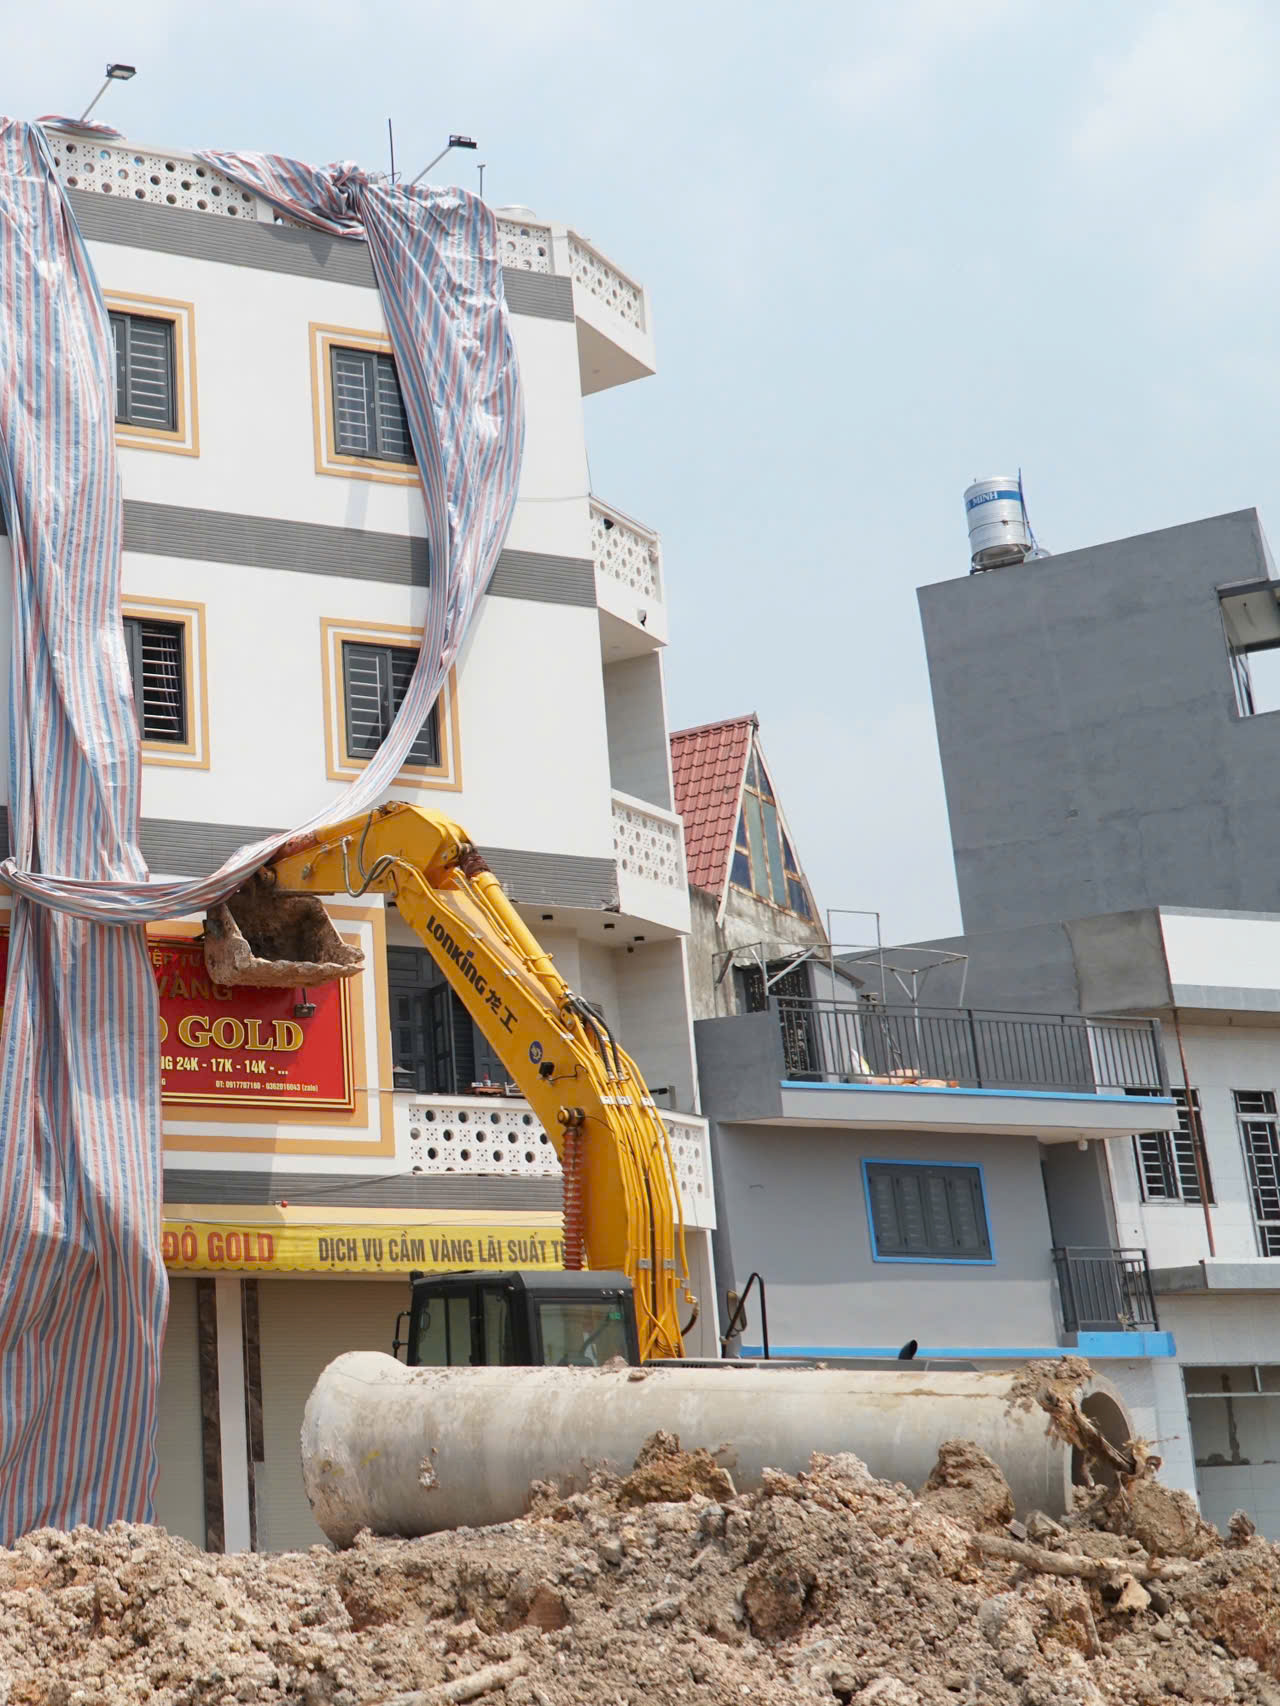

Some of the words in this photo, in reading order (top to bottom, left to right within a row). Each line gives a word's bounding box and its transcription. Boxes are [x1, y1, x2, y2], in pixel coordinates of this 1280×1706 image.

[178, 1015, 304, 1051] GOLD
[176, 1057, 199, 1071] 24K
[211, 1058, 233, 1073] 17K
[244, 1060, 266, 1074] 14K
[162, 1225, 198, 1262] ĐÔ
[207, 1231, 275, 1263] GOLD
[318, 1237, 358, 1267] DỊCH
[362, 1238, 384, 1267] VỤ
[430, 1234, 474, 1263] VÀNG
[478, 1235, 504, 1263] LÃI
[507, 1232, 548, 1263] SUẤT
